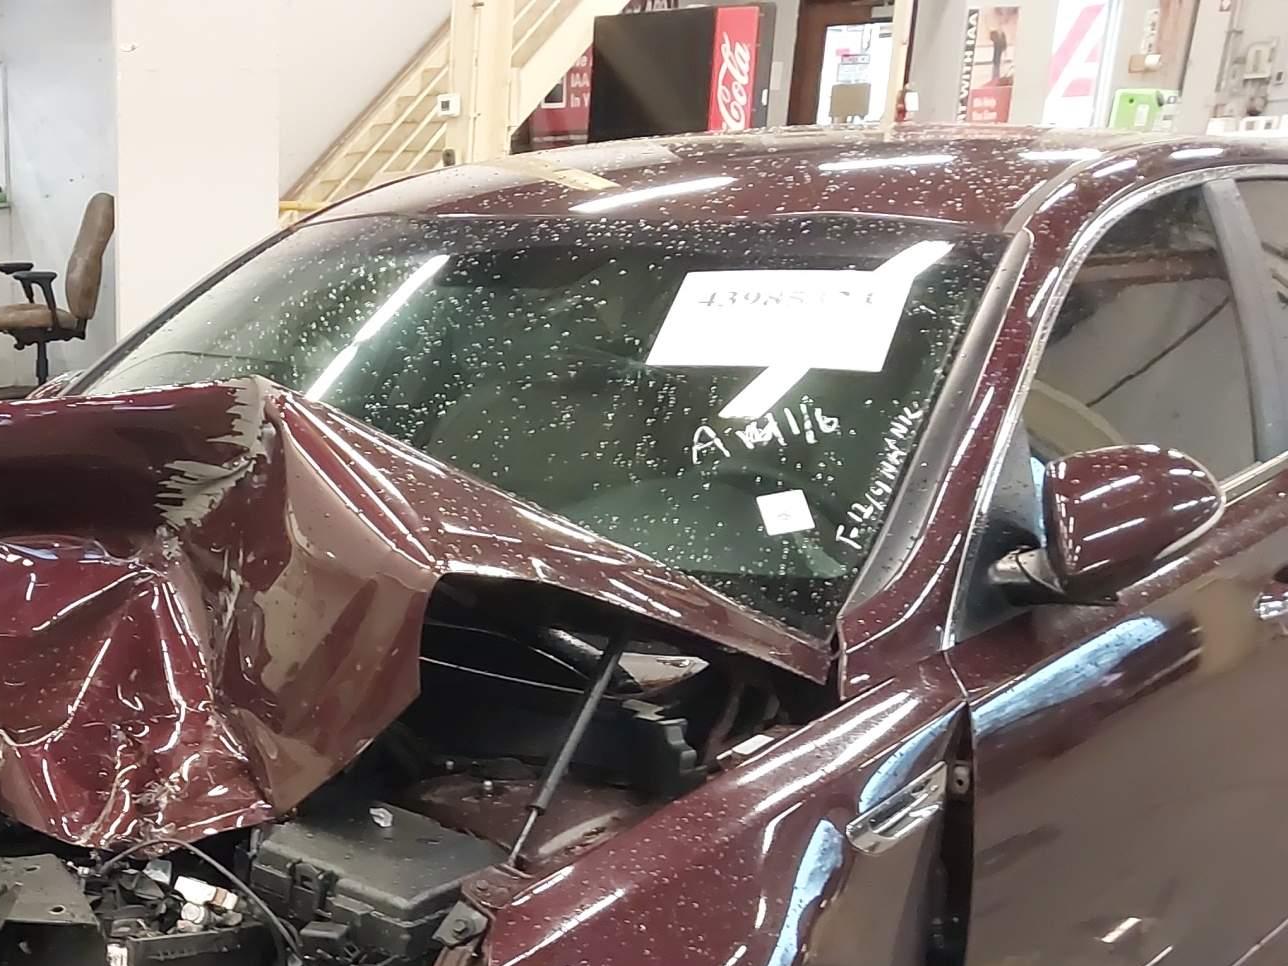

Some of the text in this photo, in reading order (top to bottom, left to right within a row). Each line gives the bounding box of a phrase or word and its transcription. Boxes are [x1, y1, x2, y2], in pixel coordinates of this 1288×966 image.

[965, 12, 979, 45] IAA
[716, 31, 750, 131] Cola
[959, 50, 974, 99] WITH
